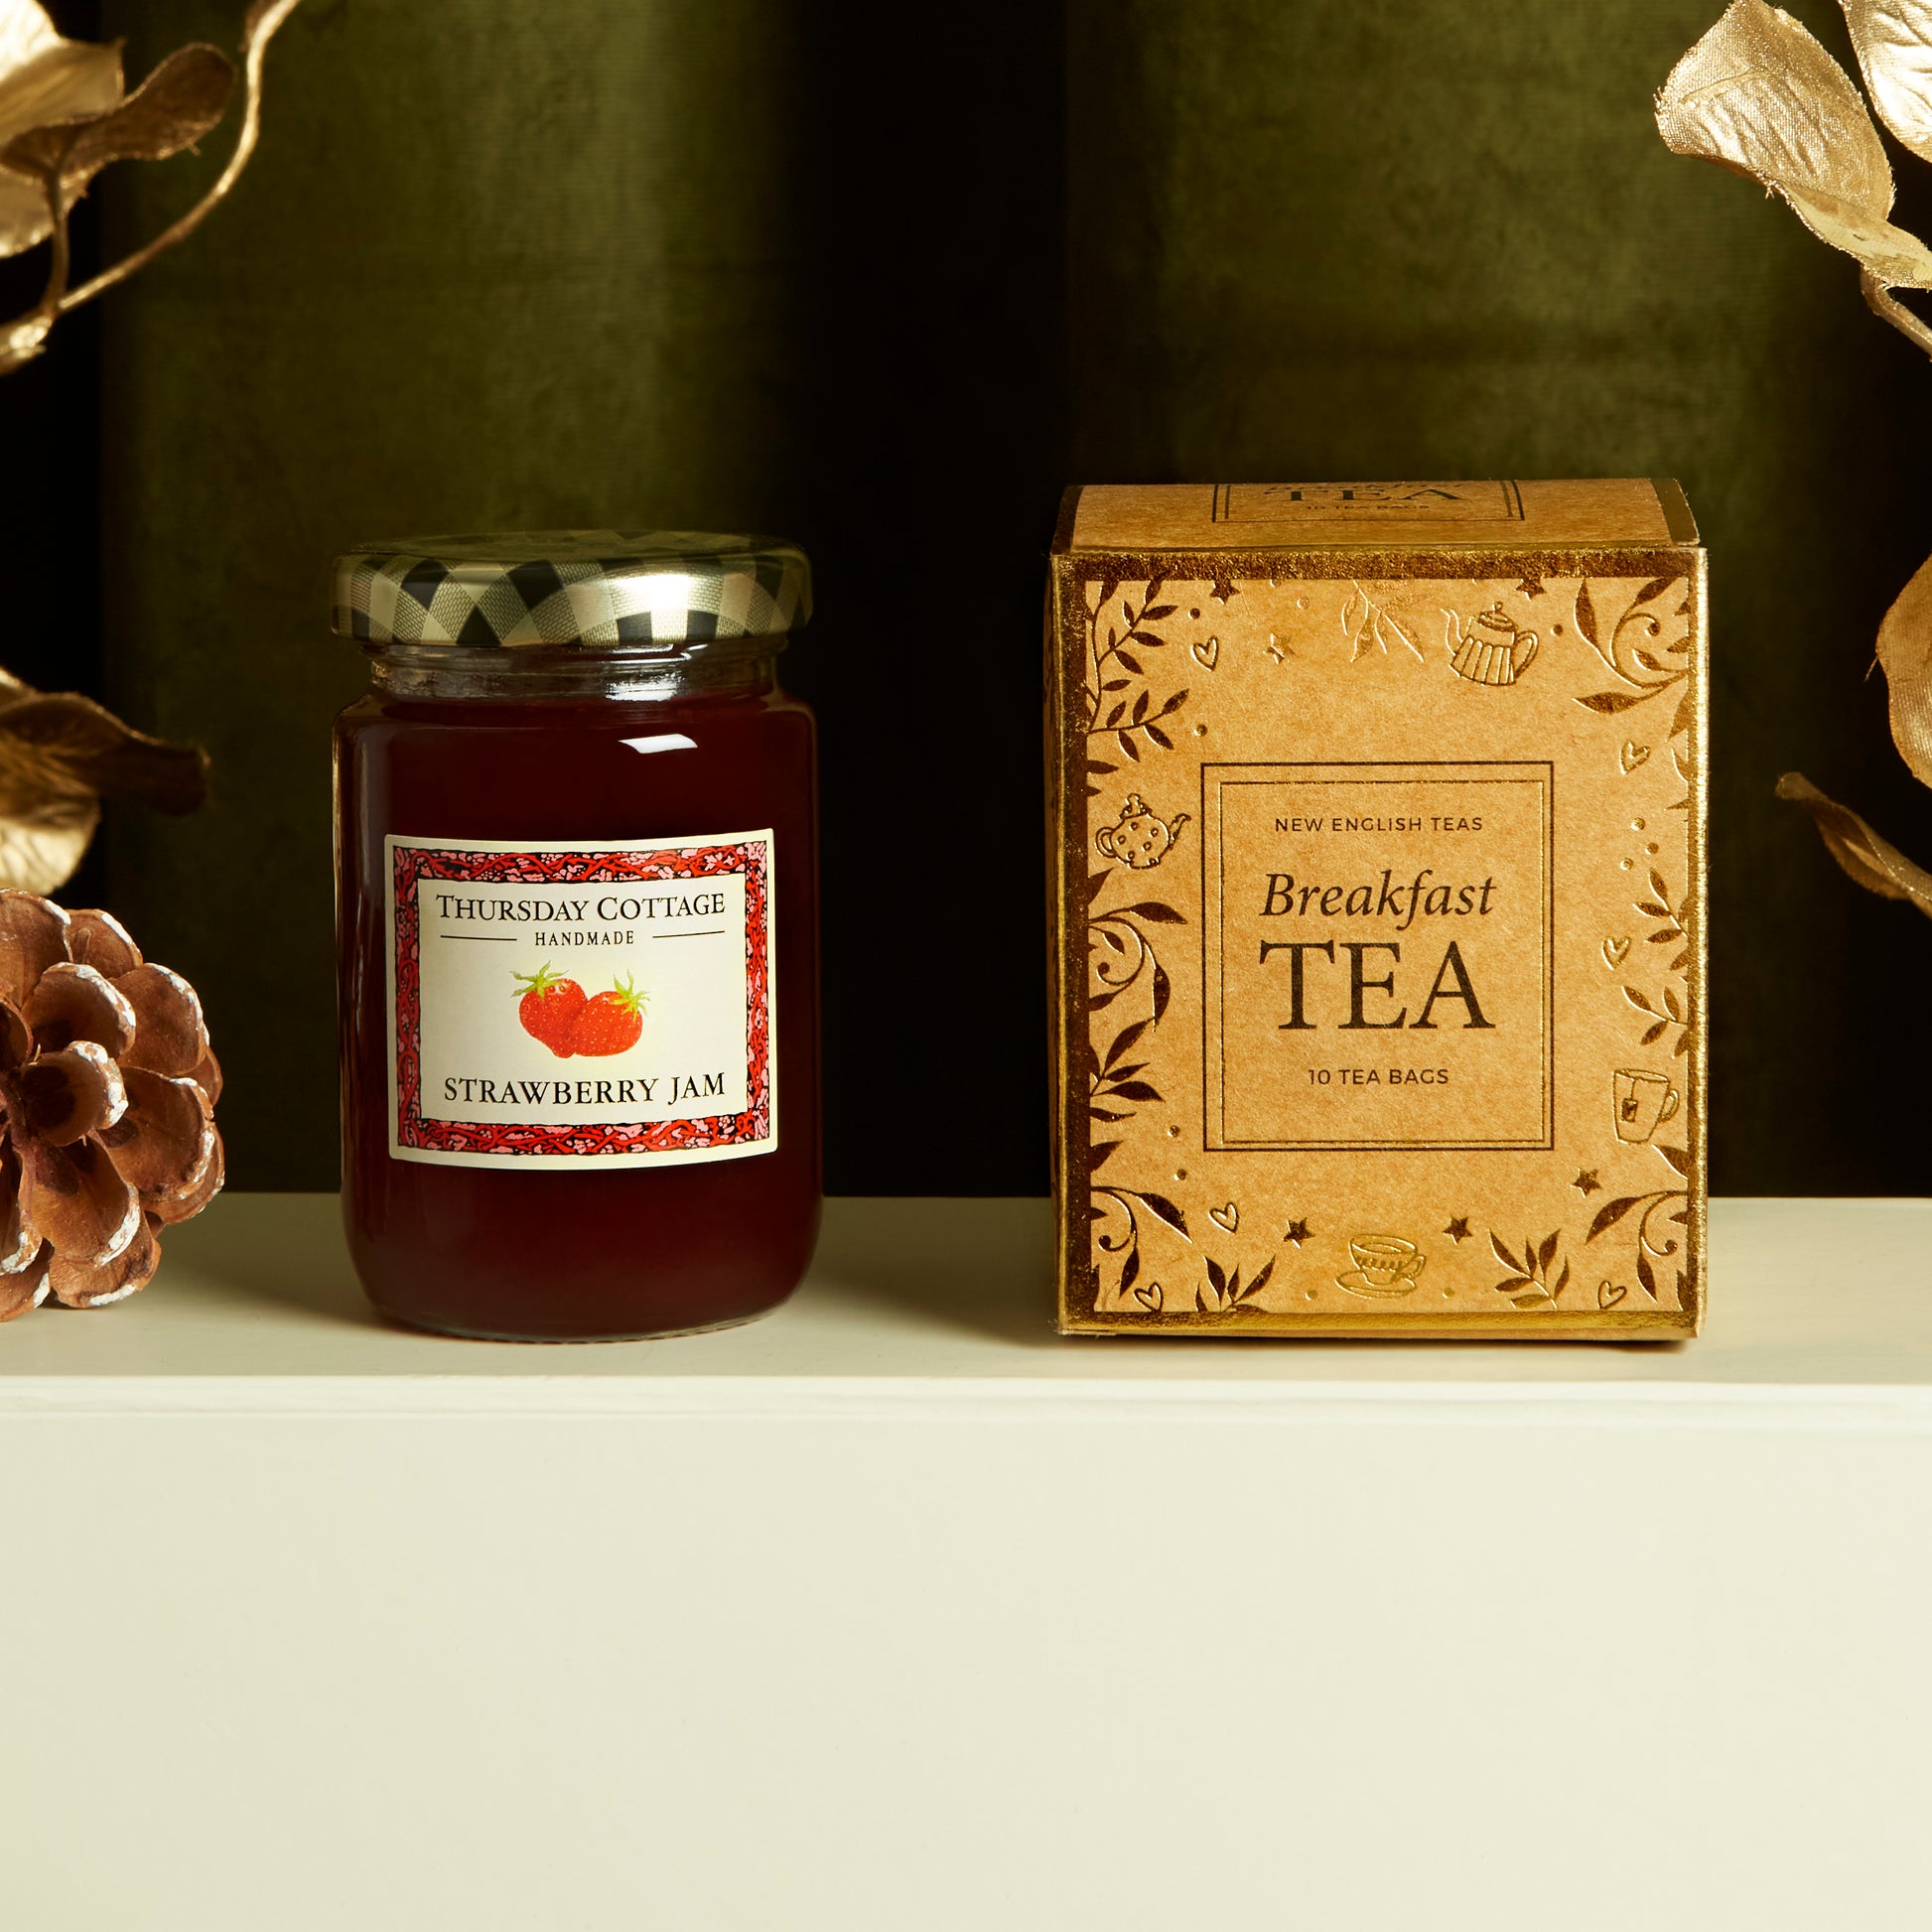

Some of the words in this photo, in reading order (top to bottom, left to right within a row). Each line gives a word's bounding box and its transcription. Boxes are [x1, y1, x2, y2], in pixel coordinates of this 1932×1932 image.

[1262, 488, 1464, 501] TEA
[1275, 817, 1323, 832] NEW
[1331, 817, 1422, 832] ENGLISH
[1430, 817, 1483, 831] TEAS
[435, 894, 590, 922] THURSDAY
[597, 893, 726, 921] COTTAGE
[1259, 869, 1497, 931] Breakfast
[534, 930, 634, 946] HANDMADE
[1259, 939, 1496, 1030] TEA
[1308, 1069, 1331, 1085] 10
[1338, 1068, 1381, 1085] TEA
[1389, 1068, 1449, 1085] BAGS
[444, 1076, 659, 1105] STRAWBERRY
[667, 1071, 726, 1106] JAM
